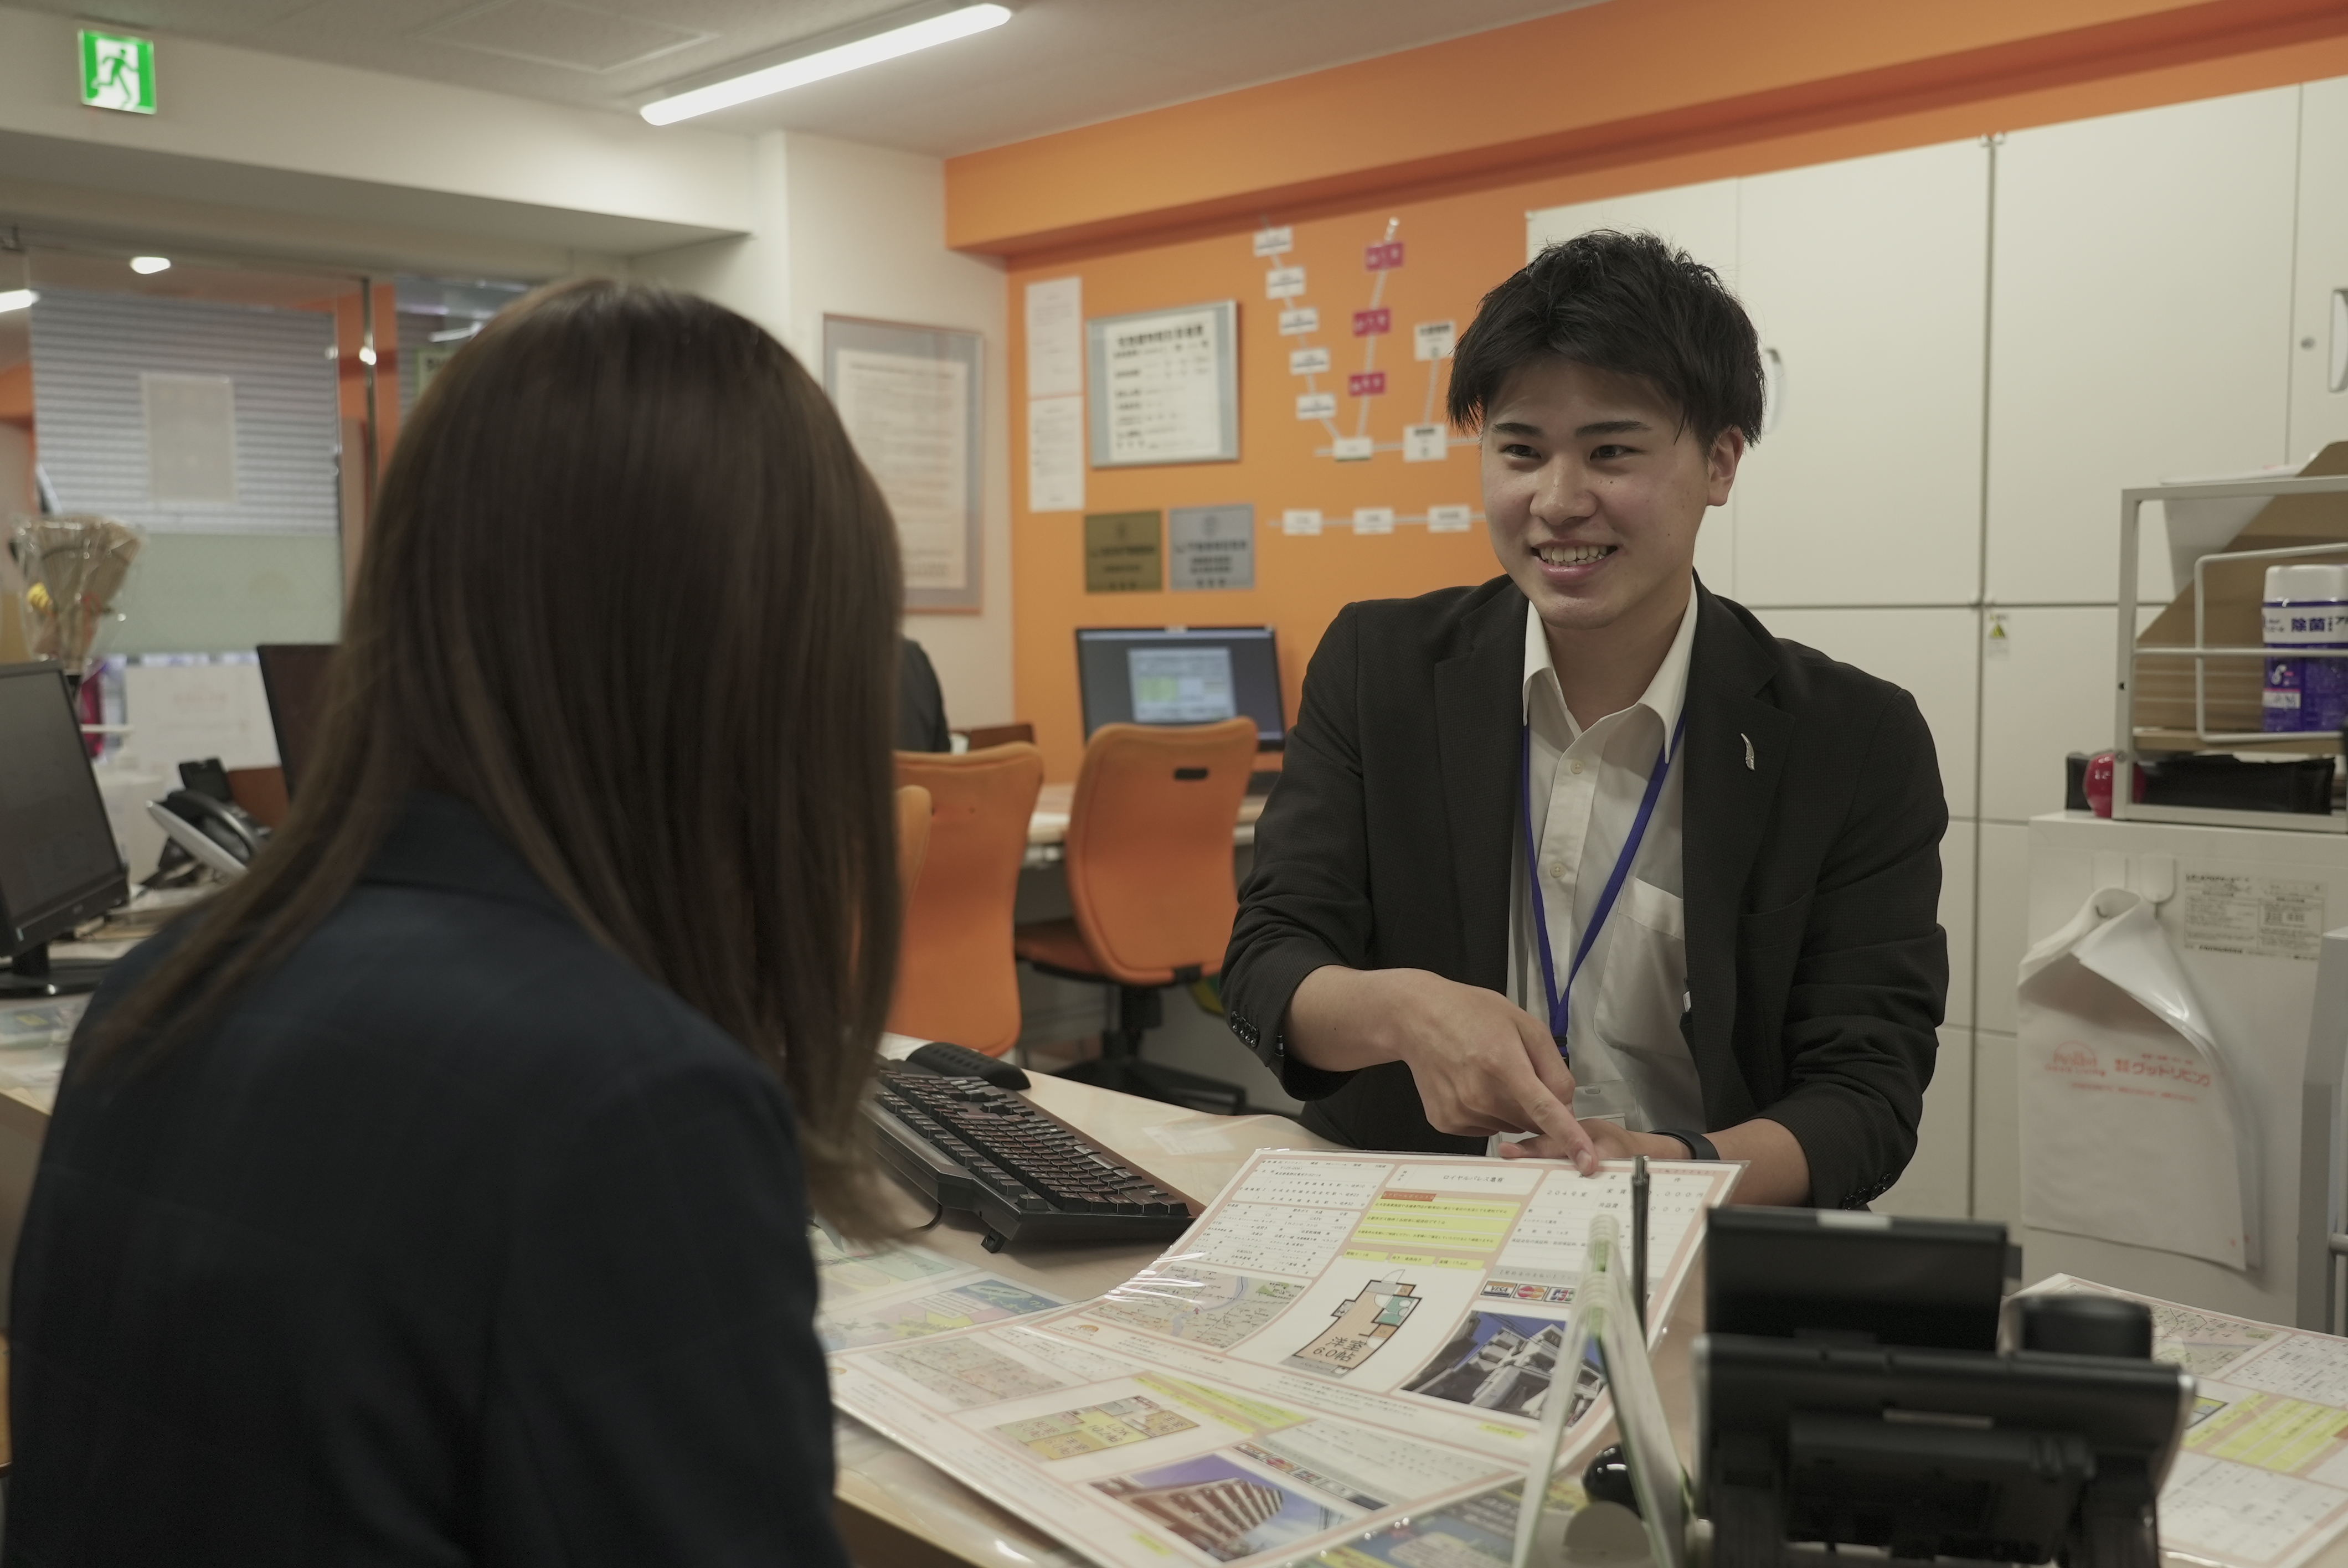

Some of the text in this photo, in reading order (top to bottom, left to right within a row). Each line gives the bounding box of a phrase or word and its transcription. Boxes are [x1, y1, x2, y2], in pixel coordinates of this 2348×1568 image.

[2292, 618, 2324, 631] 除菌
[1325, 1337, 1368, 1352] 洋室
[1313, 1347, 1356, 1362] 6.0帖
[1105, 1422, 1132, 1436] LDK
